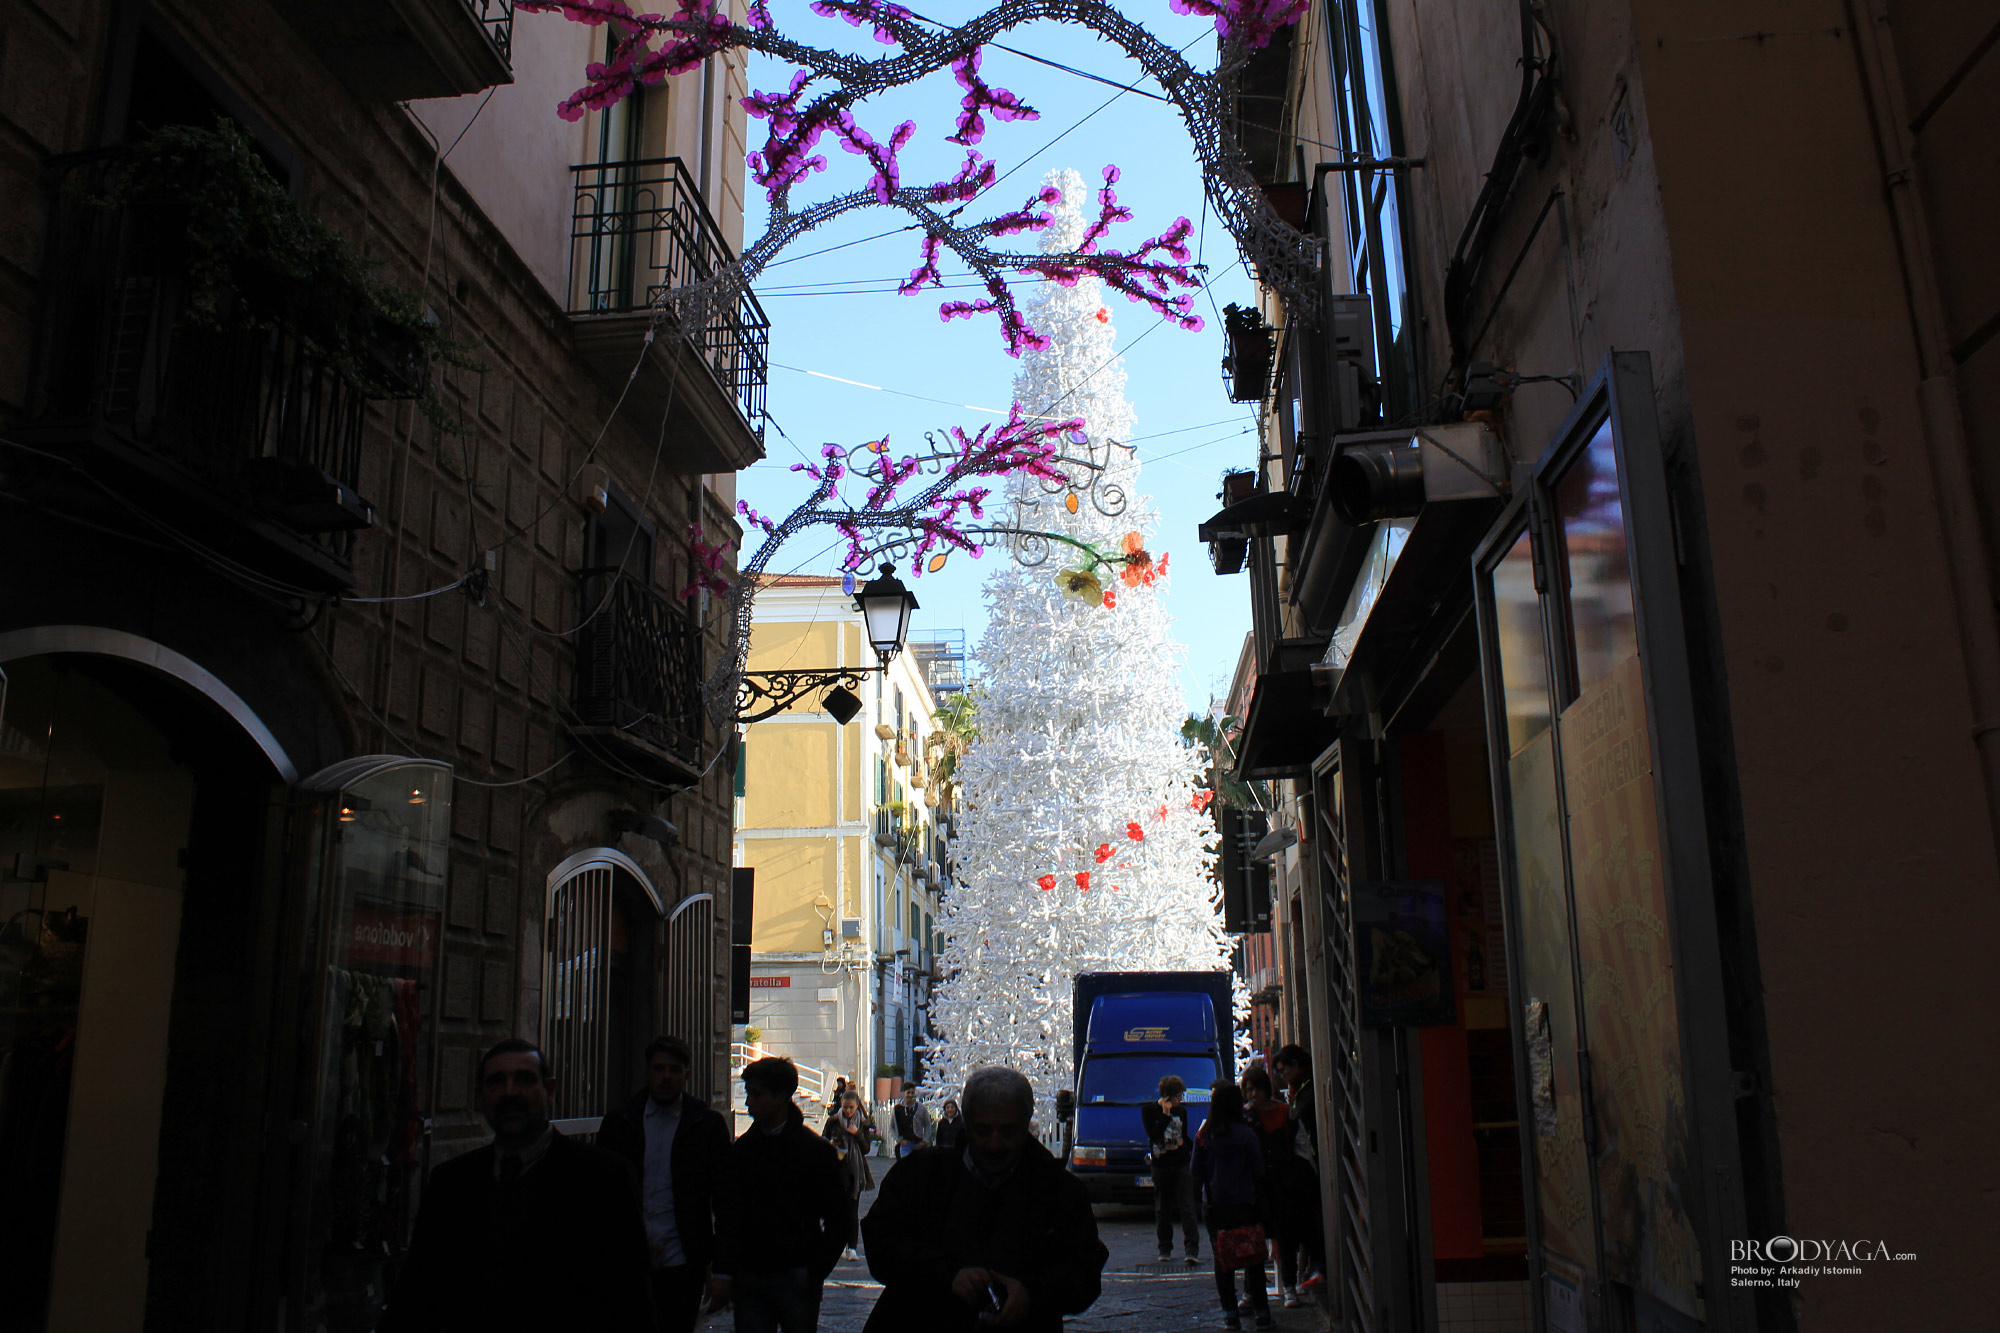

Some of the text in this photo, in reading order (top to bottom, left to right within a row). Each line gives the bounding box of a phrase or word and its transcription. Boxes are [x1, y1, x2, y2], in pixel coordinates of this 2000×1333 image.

[1573, 681, 1627, 751] PIZZERIA
[1567, 728, 1648, 812] ROSTICCERIA
[750, 977, 782, 987] atella
